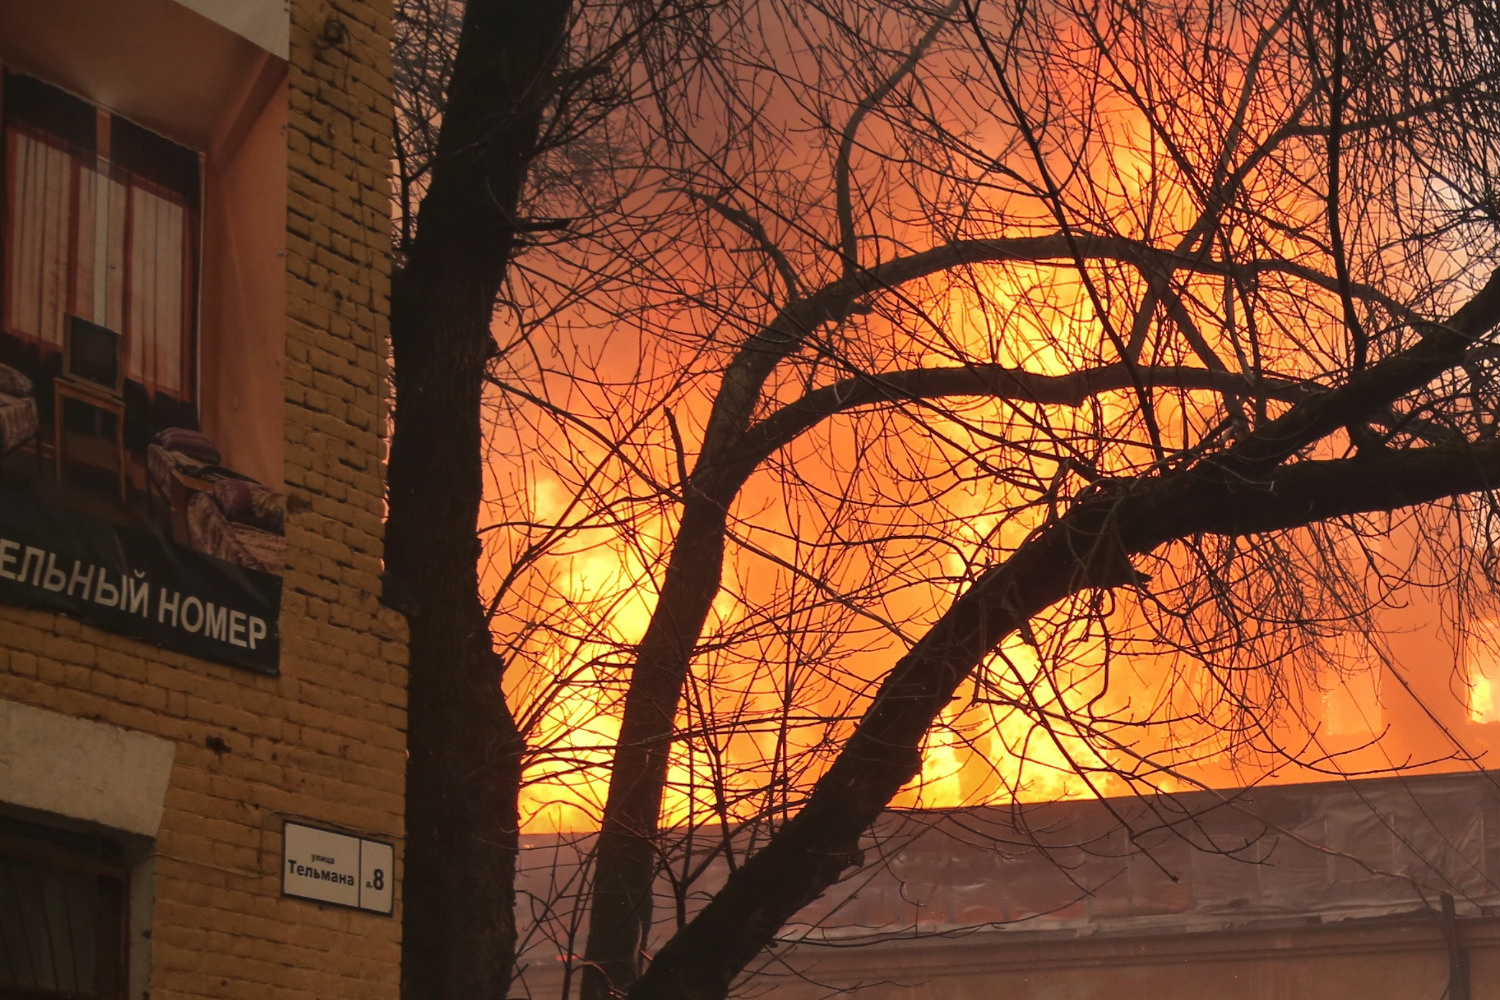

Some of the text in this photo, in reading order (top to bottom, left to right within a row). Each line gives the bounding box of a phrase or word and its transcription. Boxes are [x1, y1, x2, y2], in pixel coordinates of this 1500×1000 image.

[0, 537, 268, 651] ЕЛЬНЫЙ НОМЕР
[288, 859, 355, 887] Тельмана
[311, 854, 335, 865] улица
